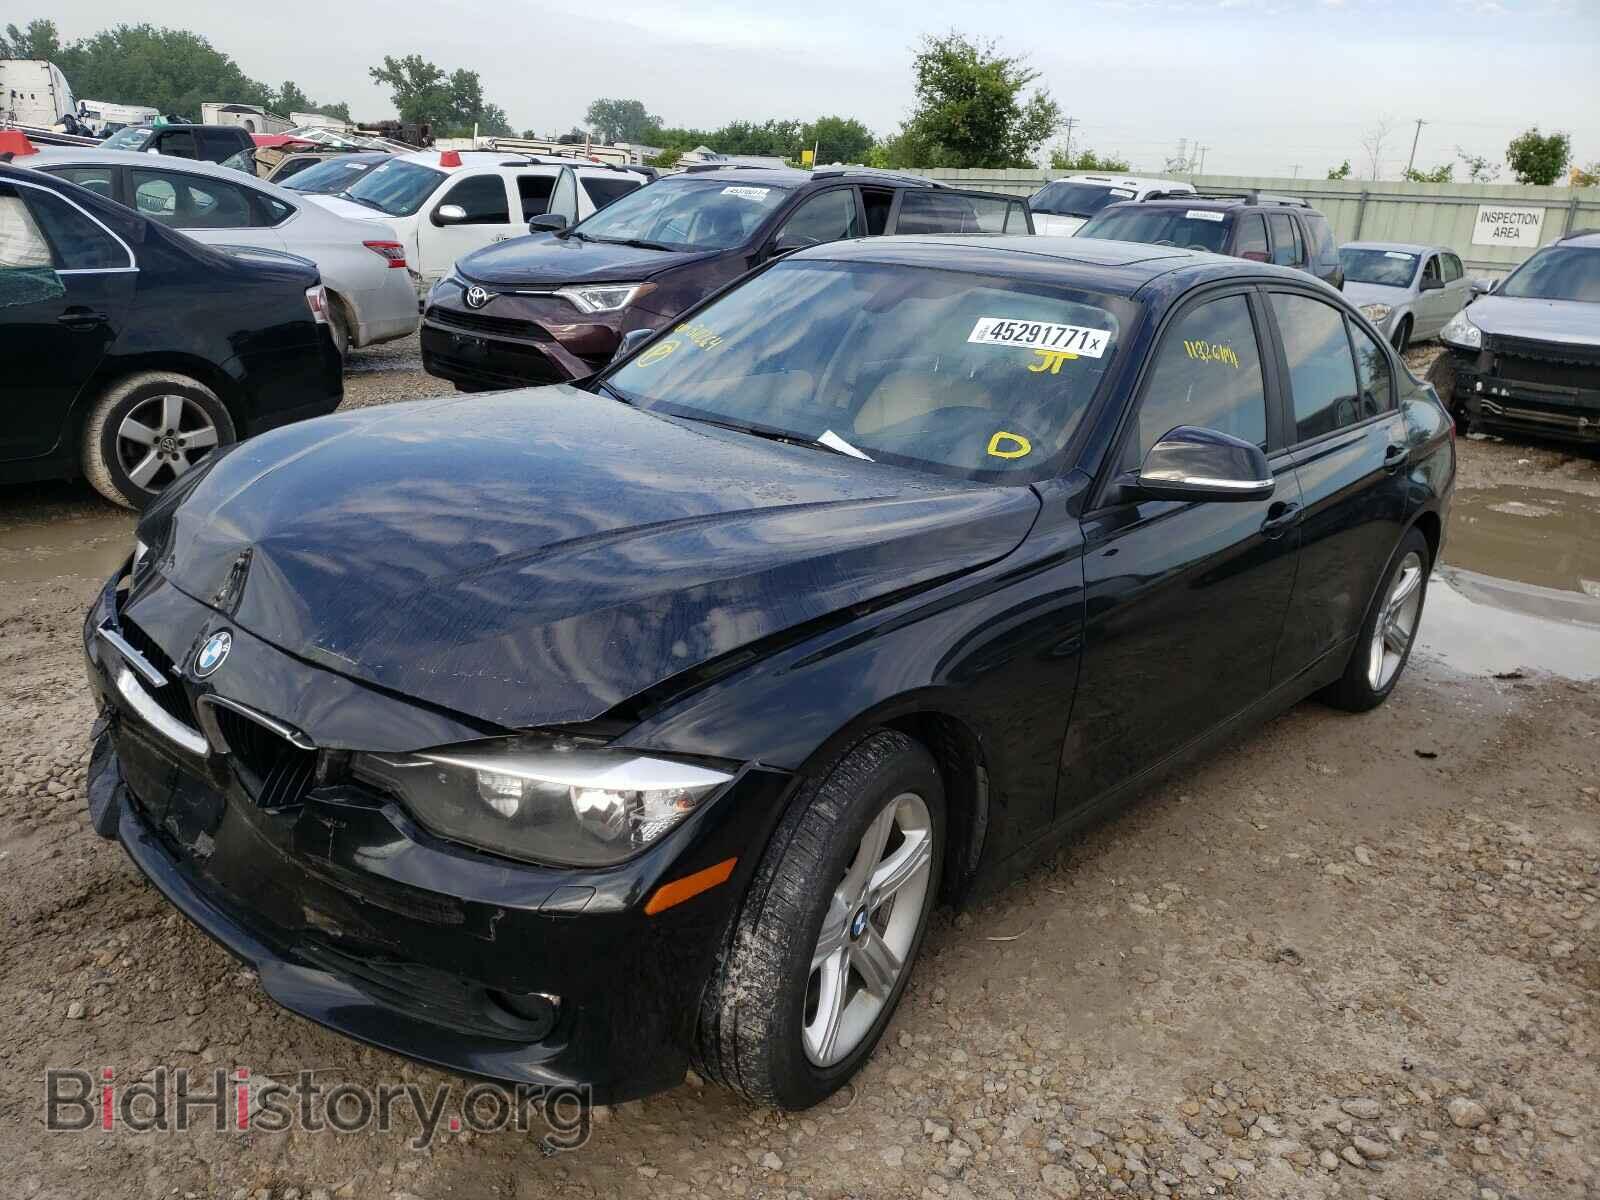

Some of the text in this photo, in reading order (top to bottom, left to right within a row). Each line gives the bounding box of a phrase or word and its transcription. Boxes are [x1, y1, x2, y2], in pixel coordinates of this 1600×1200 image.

[1480, 211, 1540, 225] INSPECTION
[1492, 226, 1520, 239] AREA
[990, 321, 1090, 350] 45291771
